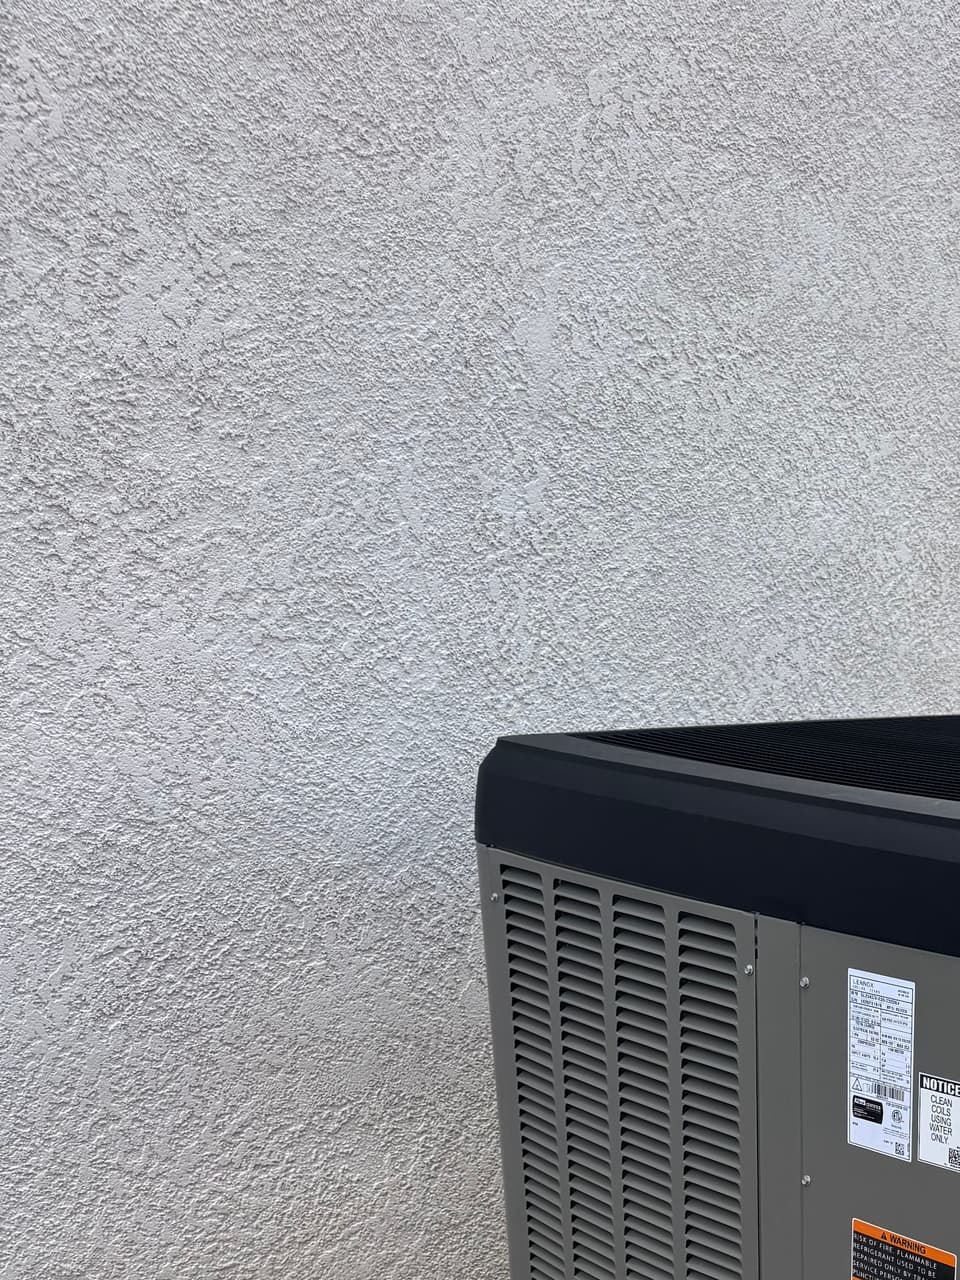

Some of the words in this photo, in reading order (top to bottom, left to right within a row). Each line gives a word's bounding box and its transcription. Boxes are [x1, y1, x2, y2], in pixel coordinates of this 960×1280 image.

[923, 1077, 960, 1097] NOTICE
[931, 1095, 952, 1108] CLEAN
[931, 1105, 951, 1117] COILS
[931, 1114, 952, 1126] USING
[929, 1123, 952, 1136] WATER
[931, 1133, 950, 1145] ONLY.
[853, 1233, 867, 1243] RISK
[868, 1238, 877, 1246] OF
[897, 1249, 937, 1270] FLAMMABLE
[890, 1233, 926, 1255] WARNING
[853, 1242, 894, 1262] REFRIGERANT
[897, 1260, 914, 1270] USED
[918, 1267, 926, 1275] TO
[928, 1270, 936, 1278] BE
[853, 1252, 882, 1267] REPAIRED
[884, 1263, 901, 1274] ONLY
[903, 1270, 912, 1278] BY
[853, 1260, 878, 1275] SERVICE
